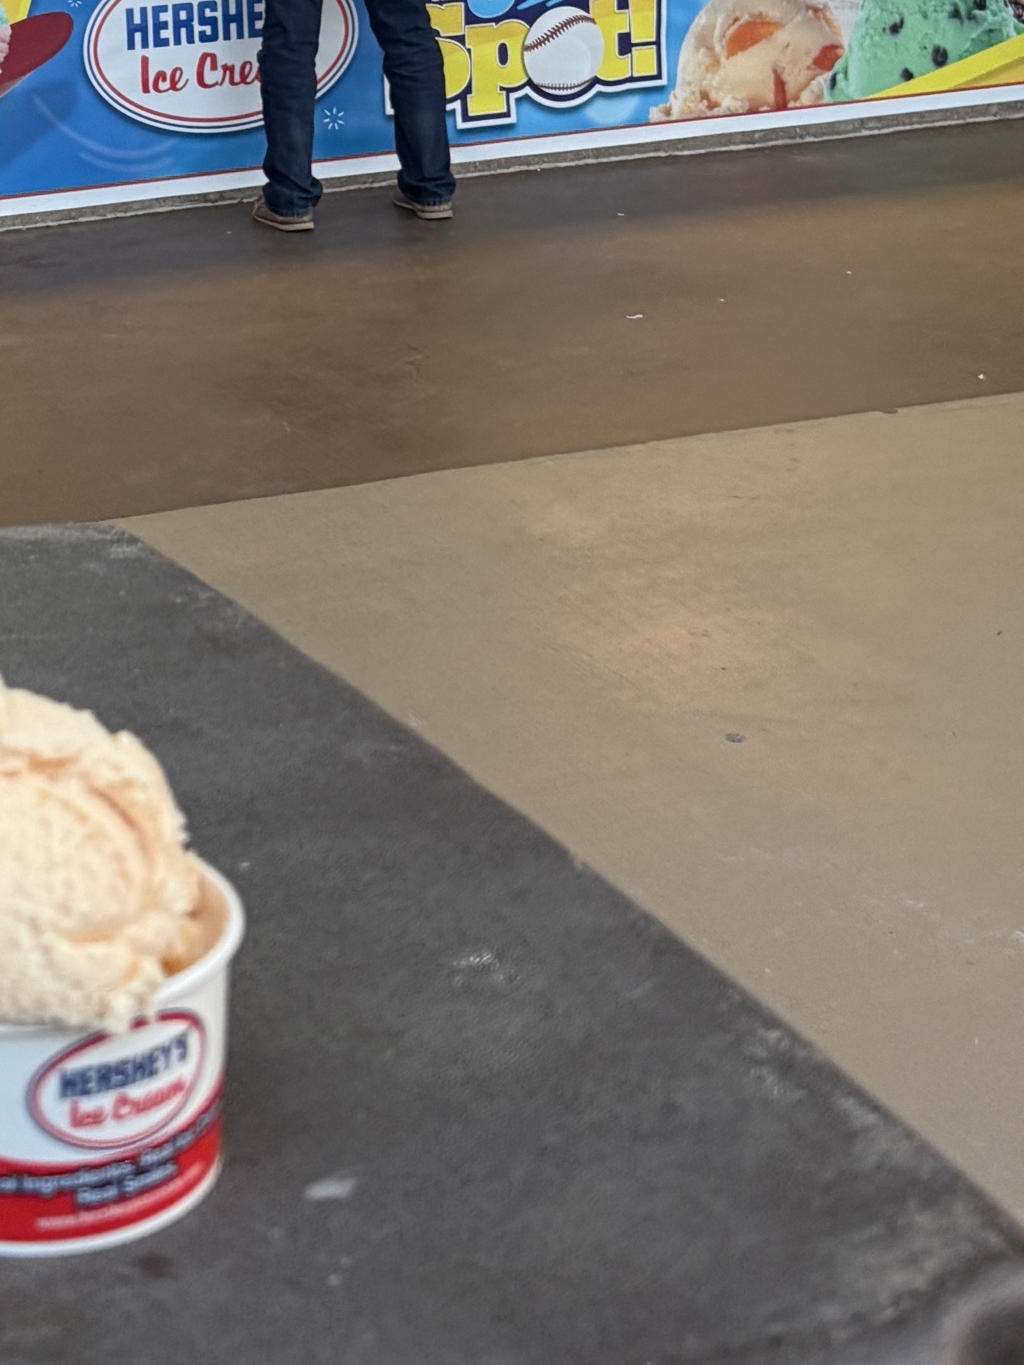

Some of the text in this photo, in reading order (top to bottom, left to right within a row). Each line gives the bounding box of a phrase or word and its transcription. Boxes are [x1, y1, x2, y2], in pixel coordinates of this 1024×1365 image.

[141, 52, 262, 94] Ice Cre
[58, 1032, 189, 1099] HERSHEY'S
[69, 1098, 106, 1129] Ice
